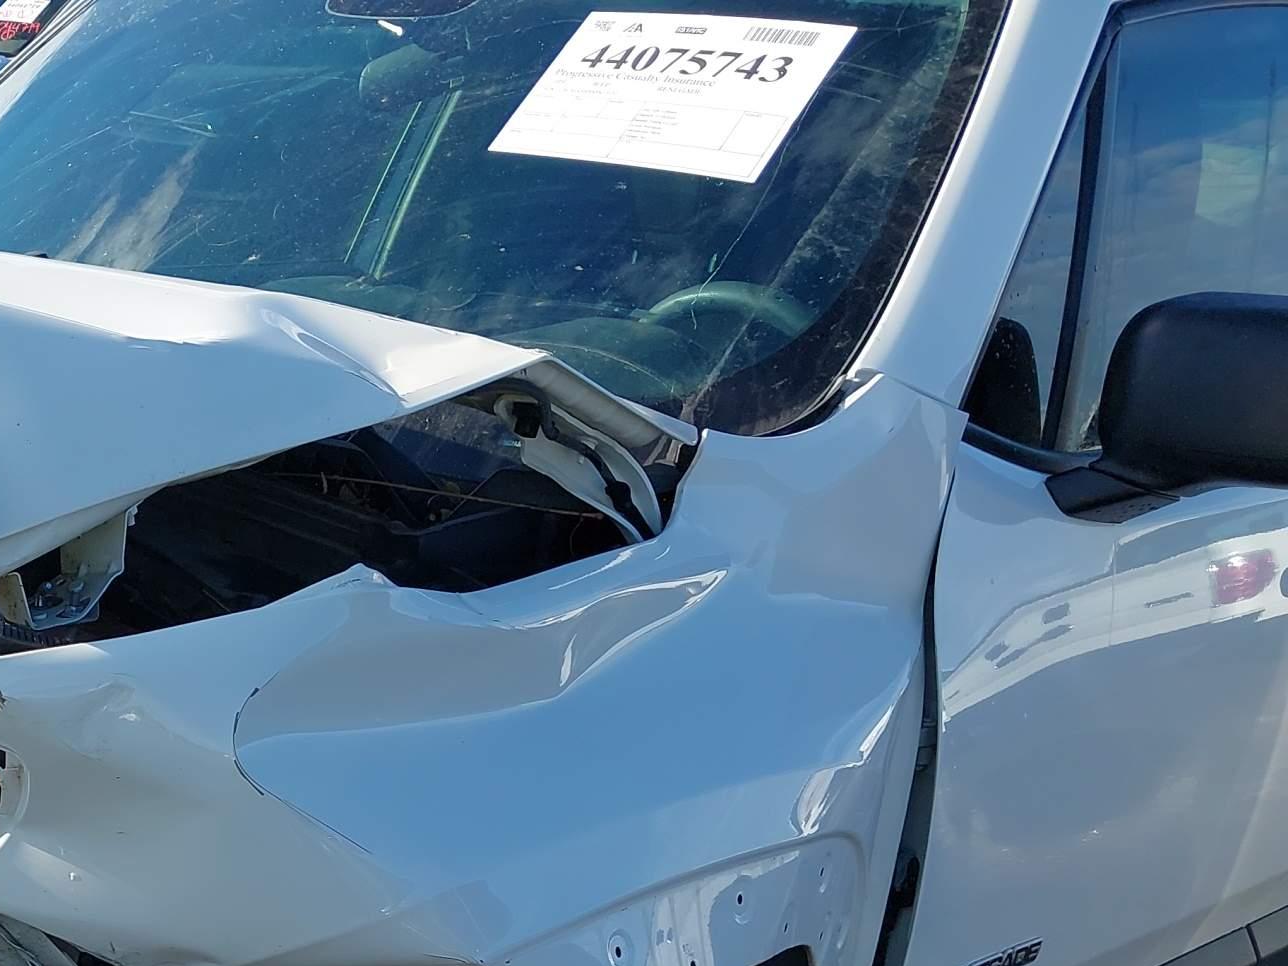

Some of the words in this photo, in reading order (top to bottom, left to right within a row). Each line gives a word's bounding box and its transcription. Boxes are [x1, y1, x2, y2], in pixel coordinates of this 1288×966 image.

[554, 67, 614, 81] Progressive
[616, 71, 660, 84] Casualty
[663, 75, 716, 88] Insurance
[580, 43, 795, 83] 44075743
